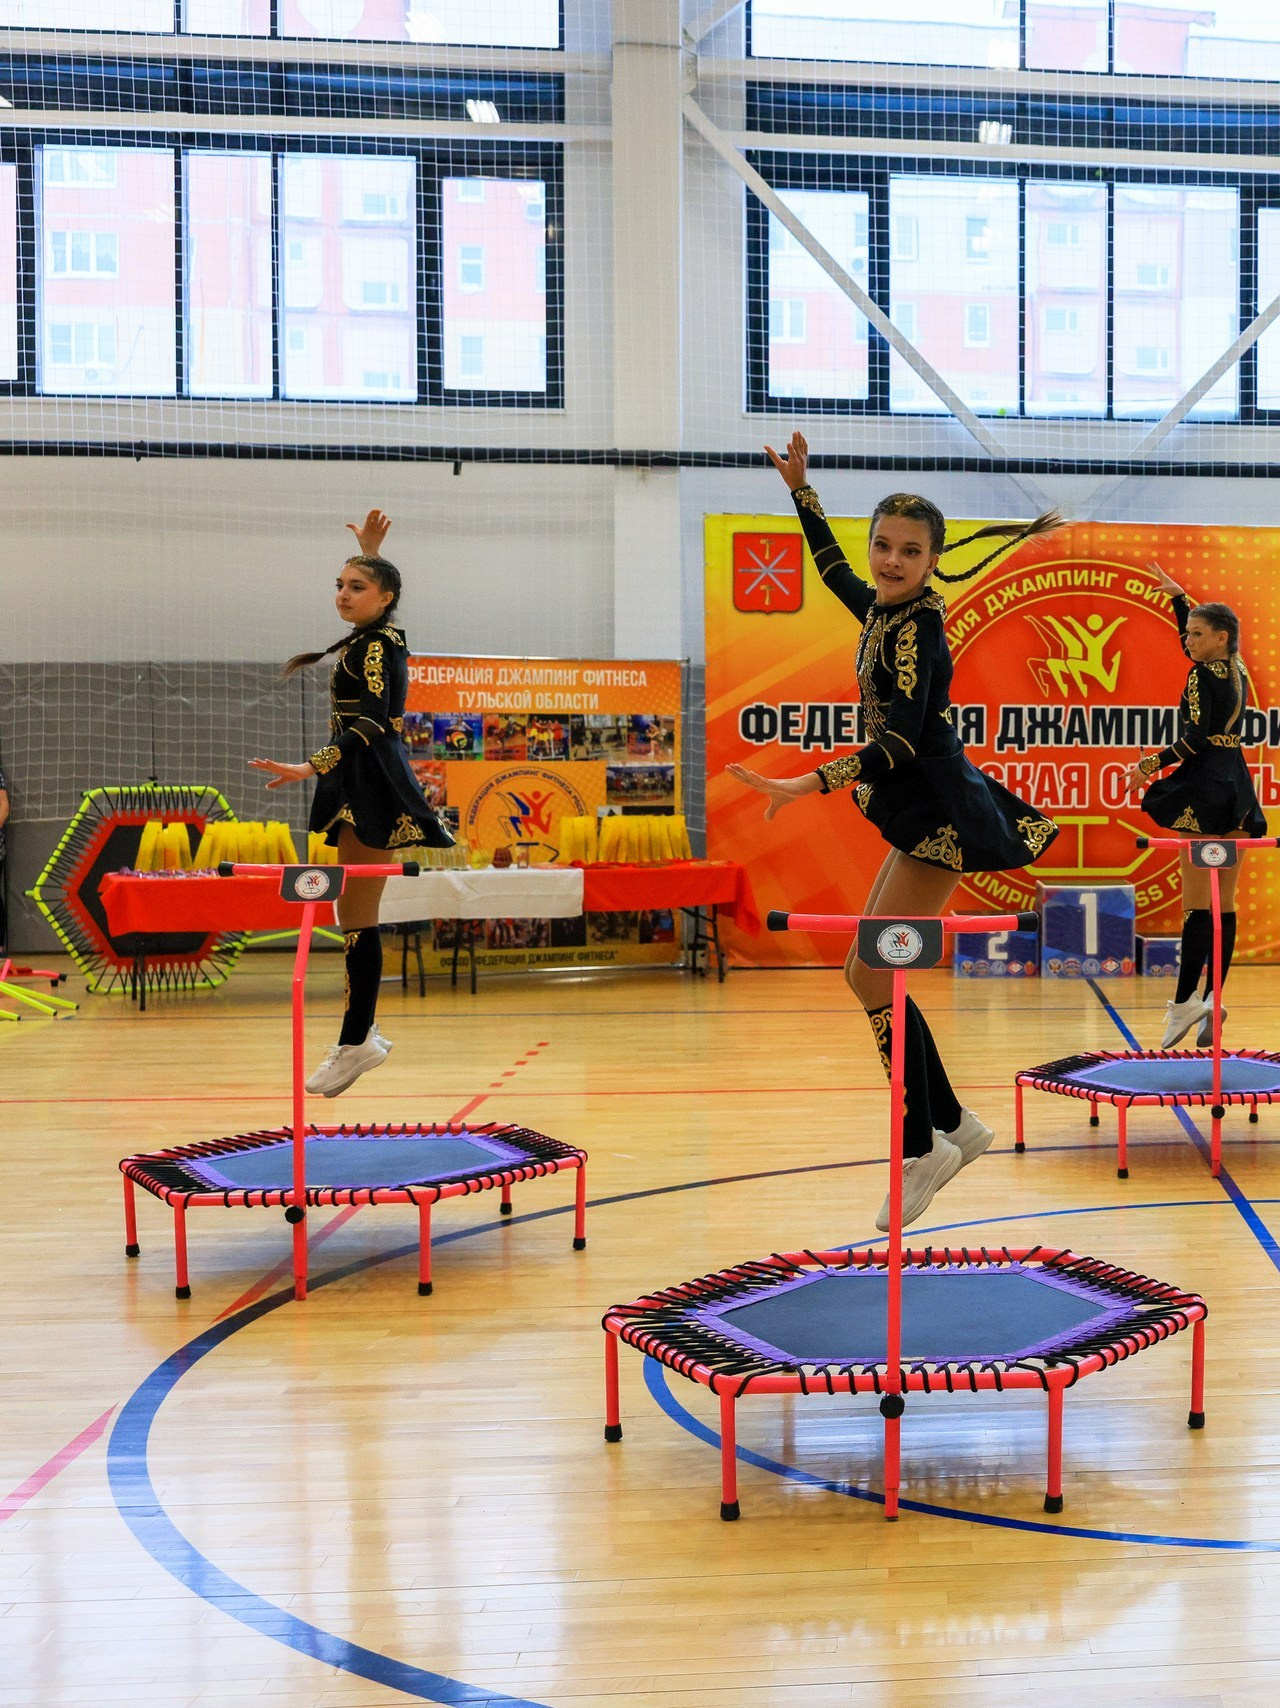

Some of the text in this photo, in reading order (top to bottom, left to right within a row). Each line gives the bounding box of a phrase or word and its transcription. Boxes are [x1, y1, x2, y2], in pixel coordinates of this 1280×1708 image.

[983, 569, 1119, 616] ДЖАМПИНГ
[408, 666, 647, 687] ФЕДЕРАЦИЯ ДЖАМПИНГ ФИТНЕСА
[457, 690, 599, 710] ТУЛЬСКОЙ ОБЛАСТИ
[1079, 893, 1098, 955] 1
[987, 931, 1009, 960] 2
